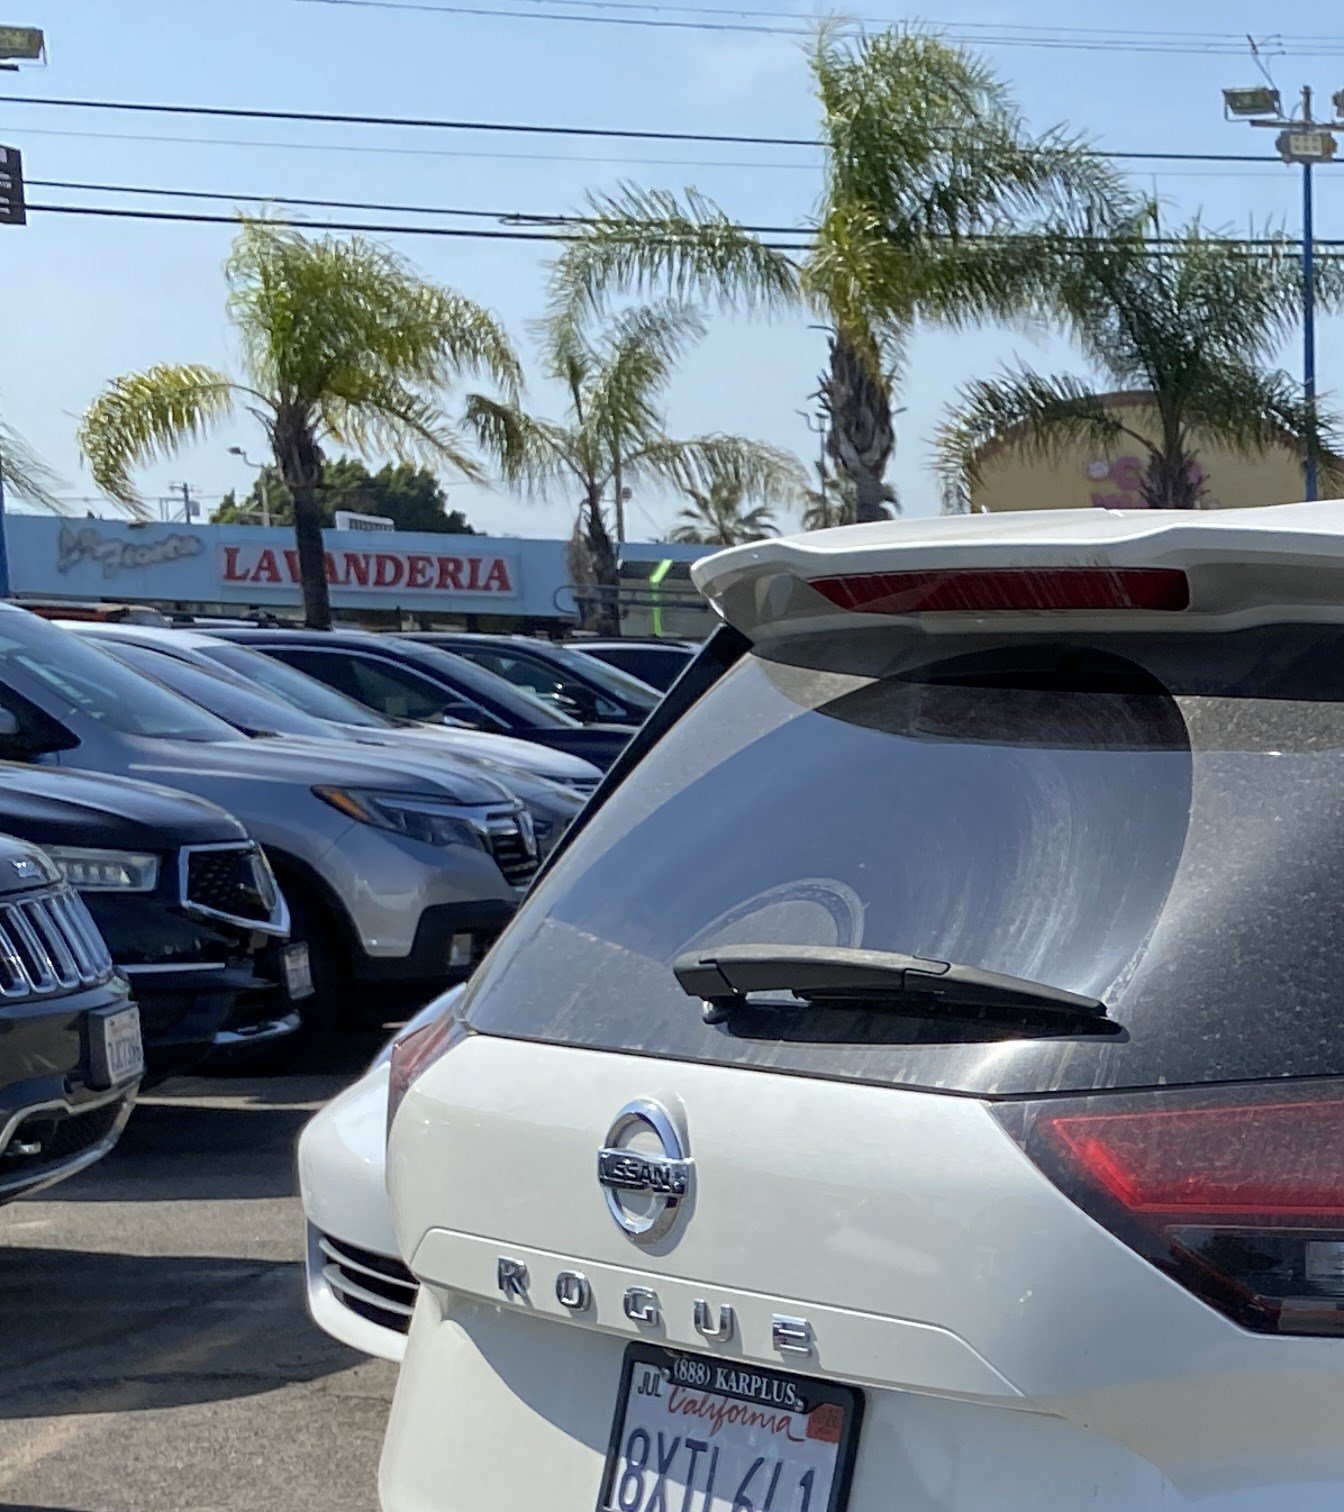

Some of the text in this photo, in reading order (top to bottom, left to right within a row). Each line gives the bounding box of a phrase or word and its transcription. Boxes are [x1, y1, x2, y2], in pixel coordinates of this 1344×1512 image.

[223, 547, 512, 592] LAVANDERIA
[600, 1154, 673, 1190] NISSAN
[498, 1256, 811, 1356] ROGUE
[637, 1369, 663, 1398] JUL
[674, 1358, 797, 1405] (888) KARPLUS
[667, 1385, 805, 1442] California
